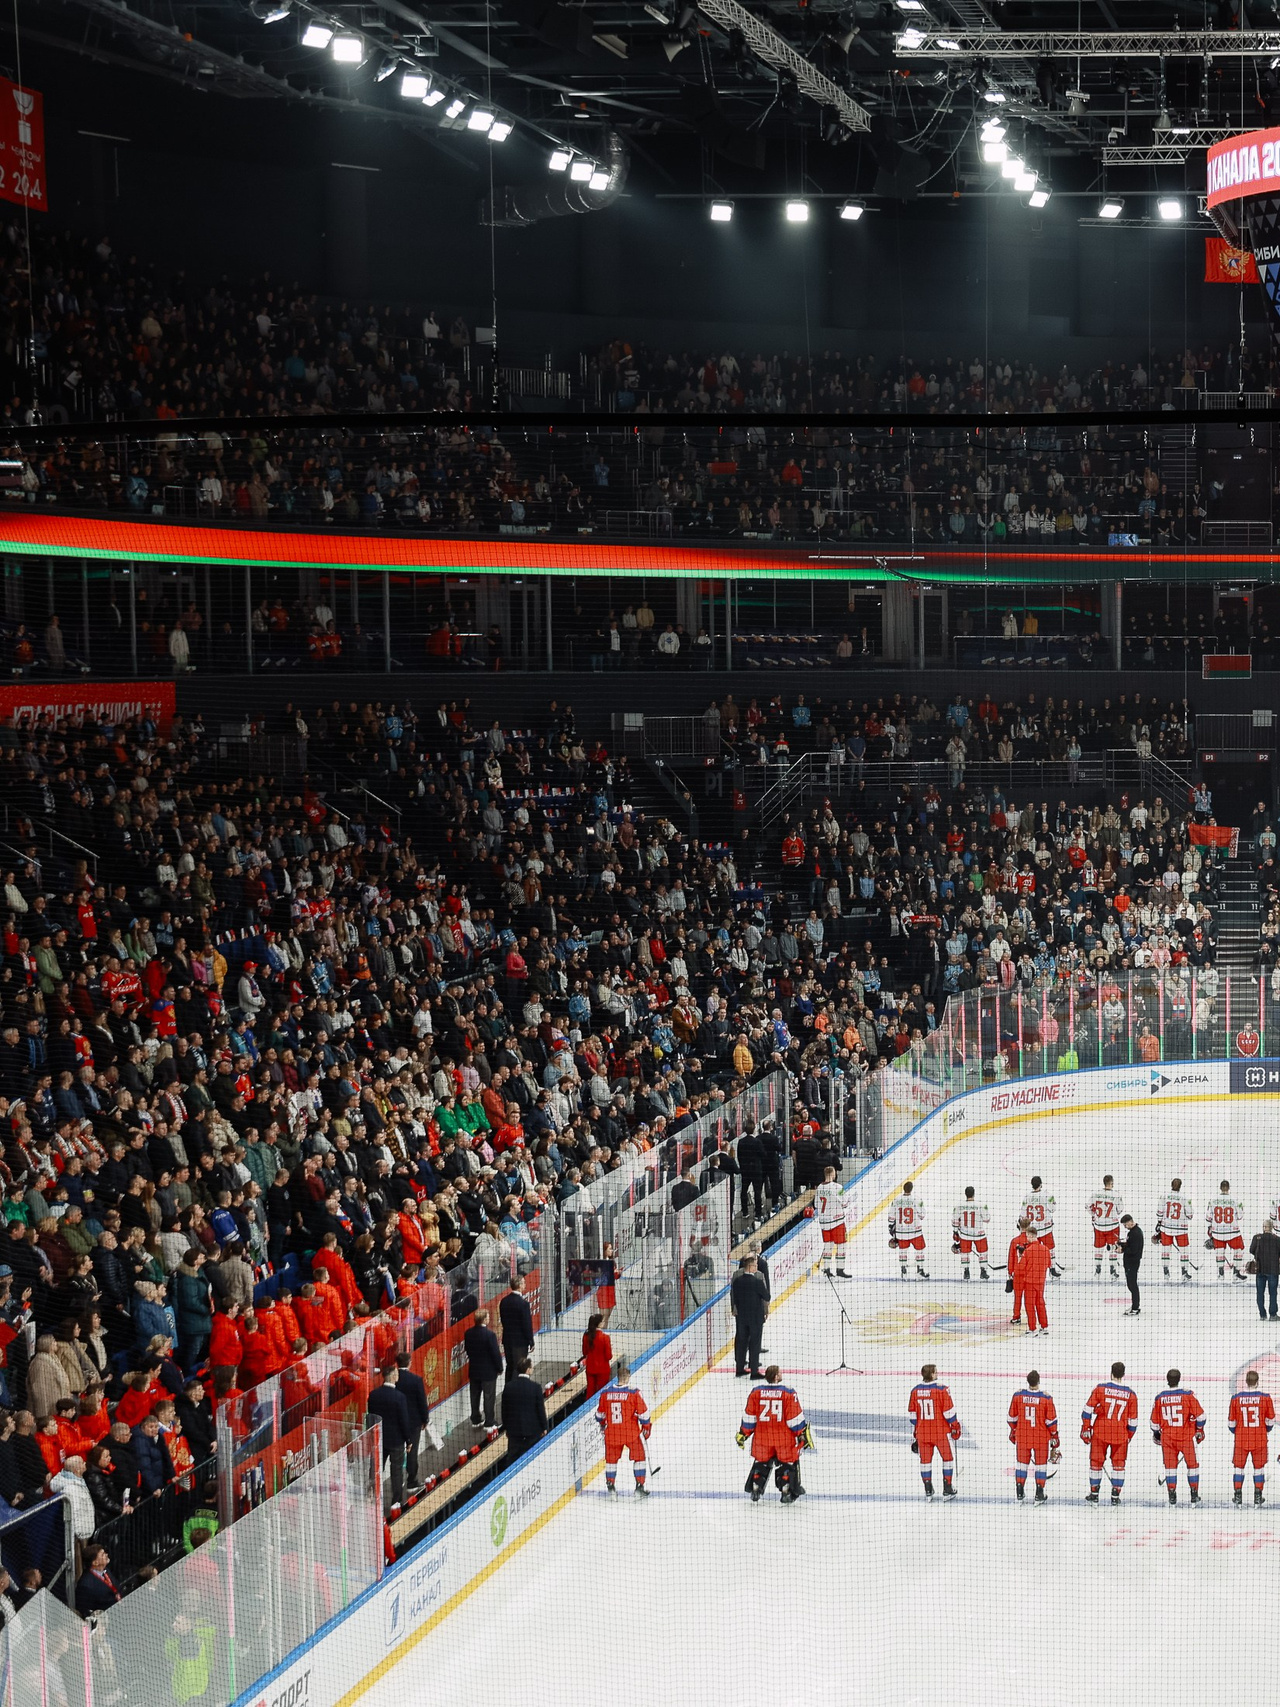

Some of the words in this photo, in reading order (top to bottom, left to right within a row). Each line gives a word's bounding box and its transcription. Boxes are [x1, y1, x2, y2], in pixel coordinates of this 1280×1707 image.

[1212, 151, 1258, 189] КАНАЛА
[1106, 1079, 1148, 1091] СИБИРЬ
[1173, 1075, 1209, 1085] АРЕНА
[990, 1093, 1010, 1112] RED
[1010, 1084, 1061, 1108] MACHINE
[819, 1196, 828, 1214] 7
[898, 1206, 914, 1225] 19
[1026, 1204, 1045, 1222] 63
[1095, 1200, 1114, 1218] 57
[1165, 1201, 1182, 1220] 13
[1213, 1205, 1235, 1224] 88
[962, 1210, 976, 1229] 11
[610, 1402, 623, 1424] 8
[759, 1399, 783, 1422] 29
[917, 1399, 935, 1420] 10
[1025, 1406, 1036, 1427] 4
[1105, 1398, 1127, 1422] 77
[1160, 1405, 1184, 1427] 45
[1240, 1406, 1261, 1428] 13
[508, 1479, 542, 1521] Airlines
[409, 1545, 448, 1592] ПЕРВЫЙ
[409, 1580, 441, 1622] КАНАЛ
